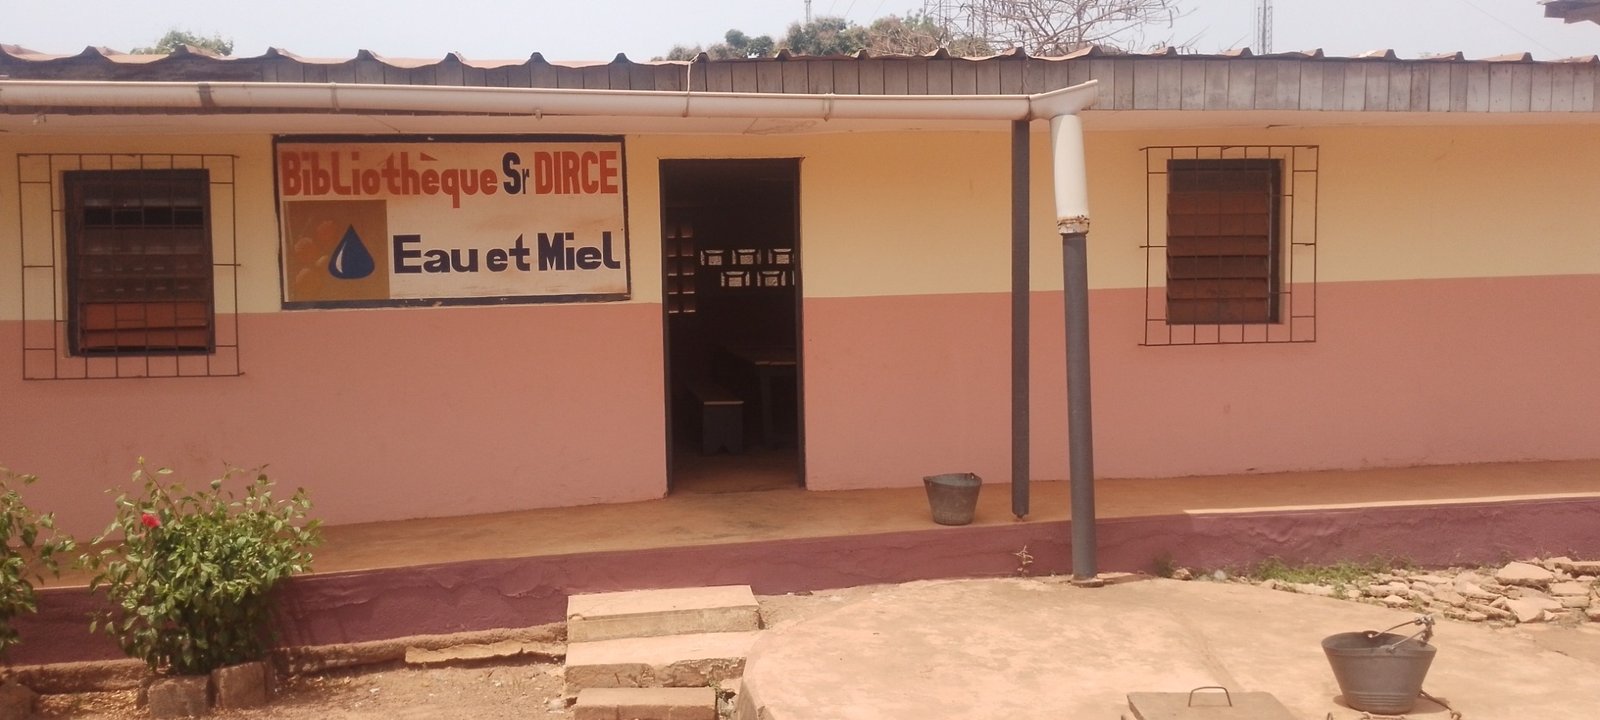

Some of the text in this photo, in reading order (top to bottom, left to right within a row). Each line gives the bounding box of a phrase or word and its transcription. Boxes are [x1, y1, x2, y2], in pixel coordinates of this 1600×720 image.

[502, 152, 530, 195] Sr
[534, 150, 619, 195] DIRCE
[393, 234, 479, 274] Eau
[486, 232, 531, 272] et
